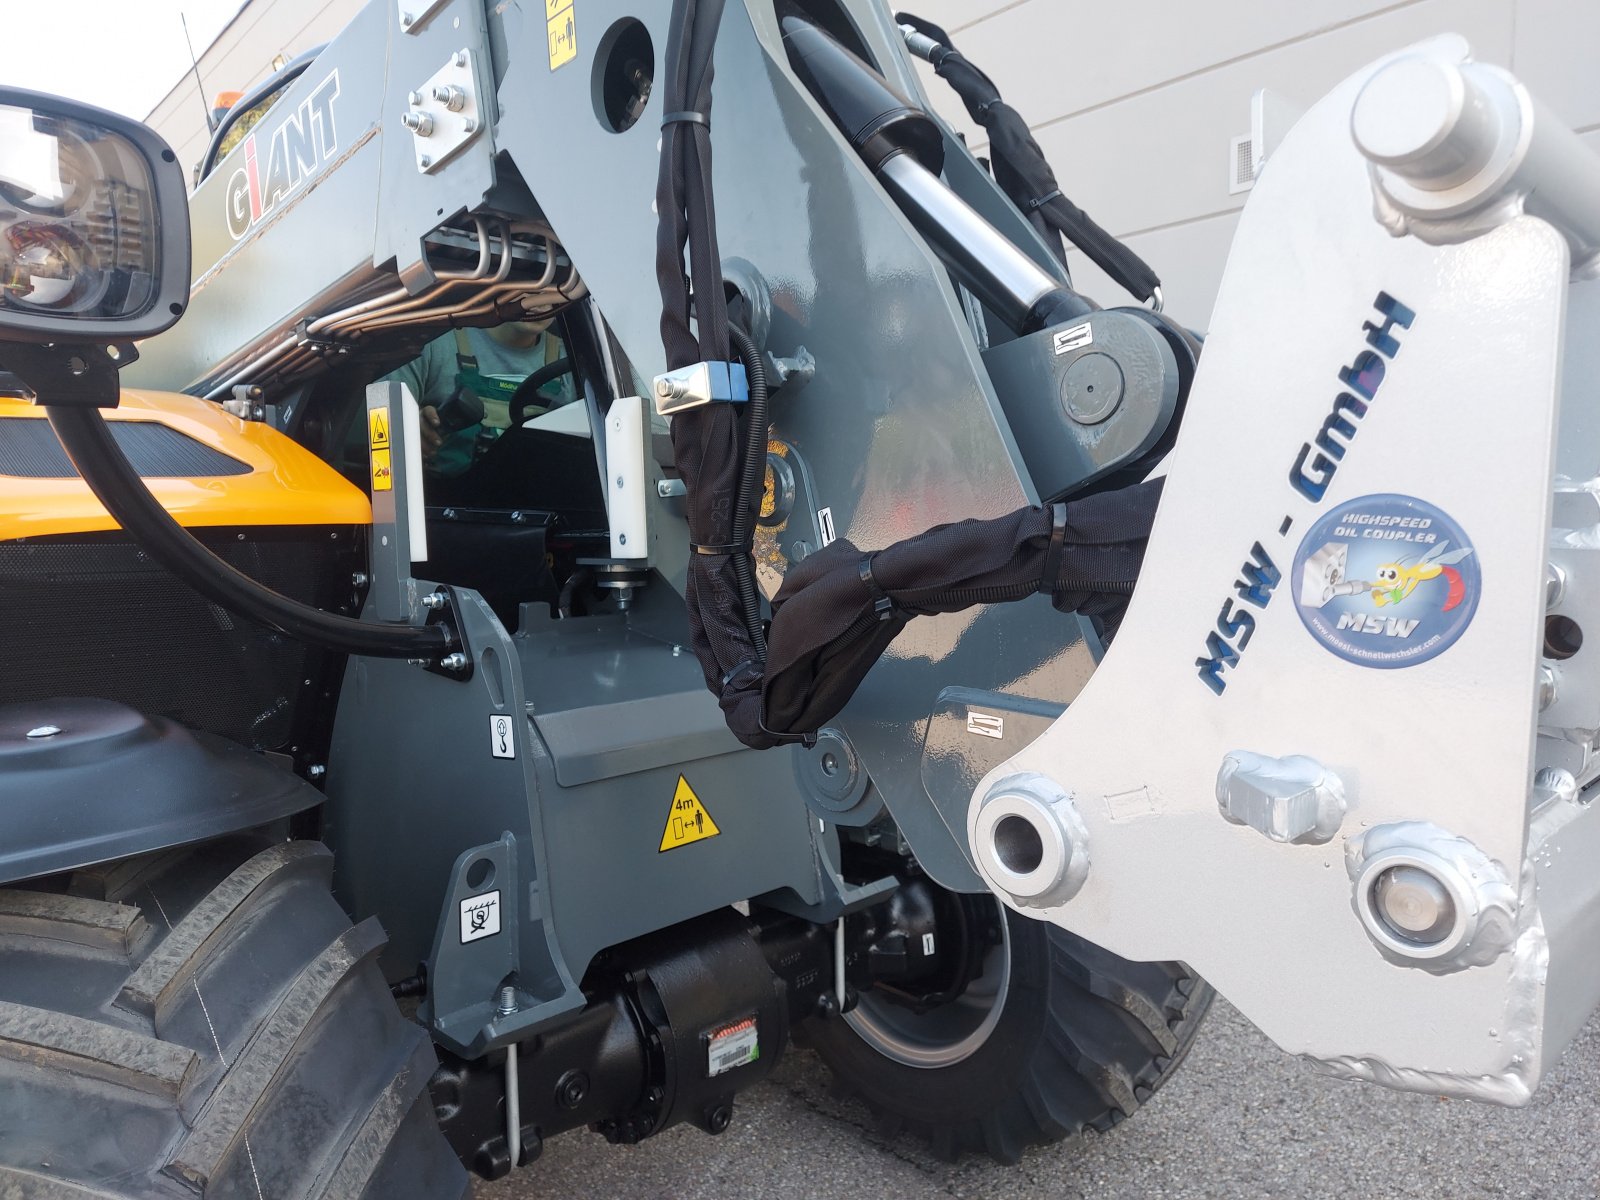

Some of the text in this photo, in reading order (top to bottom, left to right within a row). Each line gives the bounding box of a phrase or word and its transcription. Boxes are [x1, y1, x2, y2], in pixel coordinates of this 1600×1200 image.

[1195, 540, 1282, 697] MSW
[1289, 290, 1416, 503] GmbH
[1341, 513, 1432, 529] HIGHSPEED
[1333, 526, 1437, 544] OIL COUPLER
[1335, 612, 1421, 639] MSW
[675, 798, 694, 811] 4m
